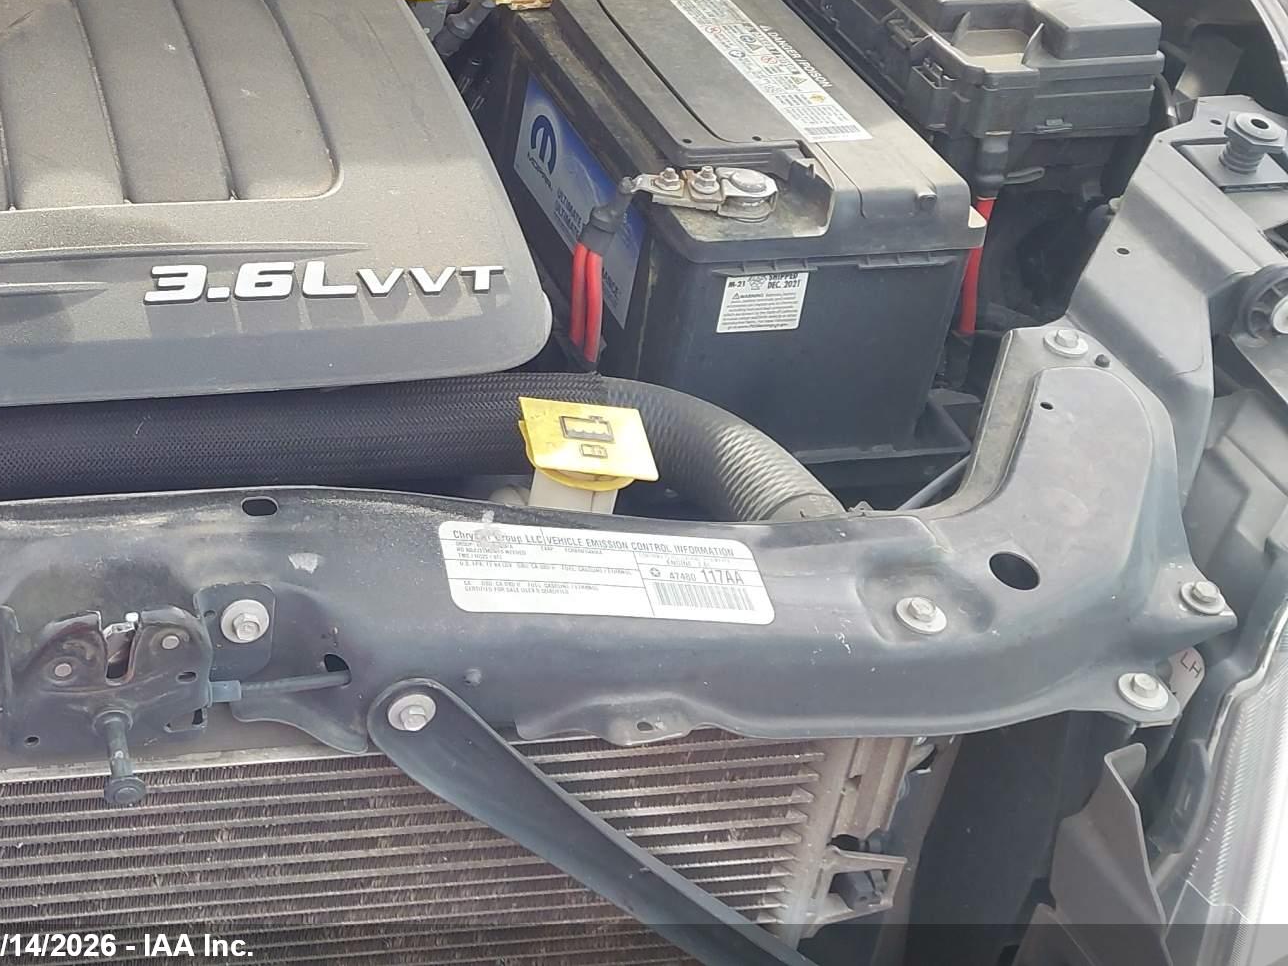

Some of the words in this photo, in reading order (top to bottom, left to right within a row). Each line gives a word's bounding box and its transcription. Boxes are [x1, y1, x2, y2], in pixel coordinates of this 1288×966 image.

[767, 32, 802, 59] DANGER
[799, 62, 832, 87] POISON
[143, 260, 358, 305] 3.6L
[357, 264, 505, 296] VVT
[767, 281, 781, 289] DEC.
[784, 280, 800, 288] 2021
[525, 534, 543, 544] LLC
[546, 536, 583, 547] VEHICLE
[586, 538, 628, 550] EMISSION
[631, 542, 671, 553] CONTROL
[674, 545, 734, 557] INFORMATION
[670, 572, 697, 581] 47480
[701, 569, 745, 584] 117AA
[1180, 651, 1203, 678] LH
